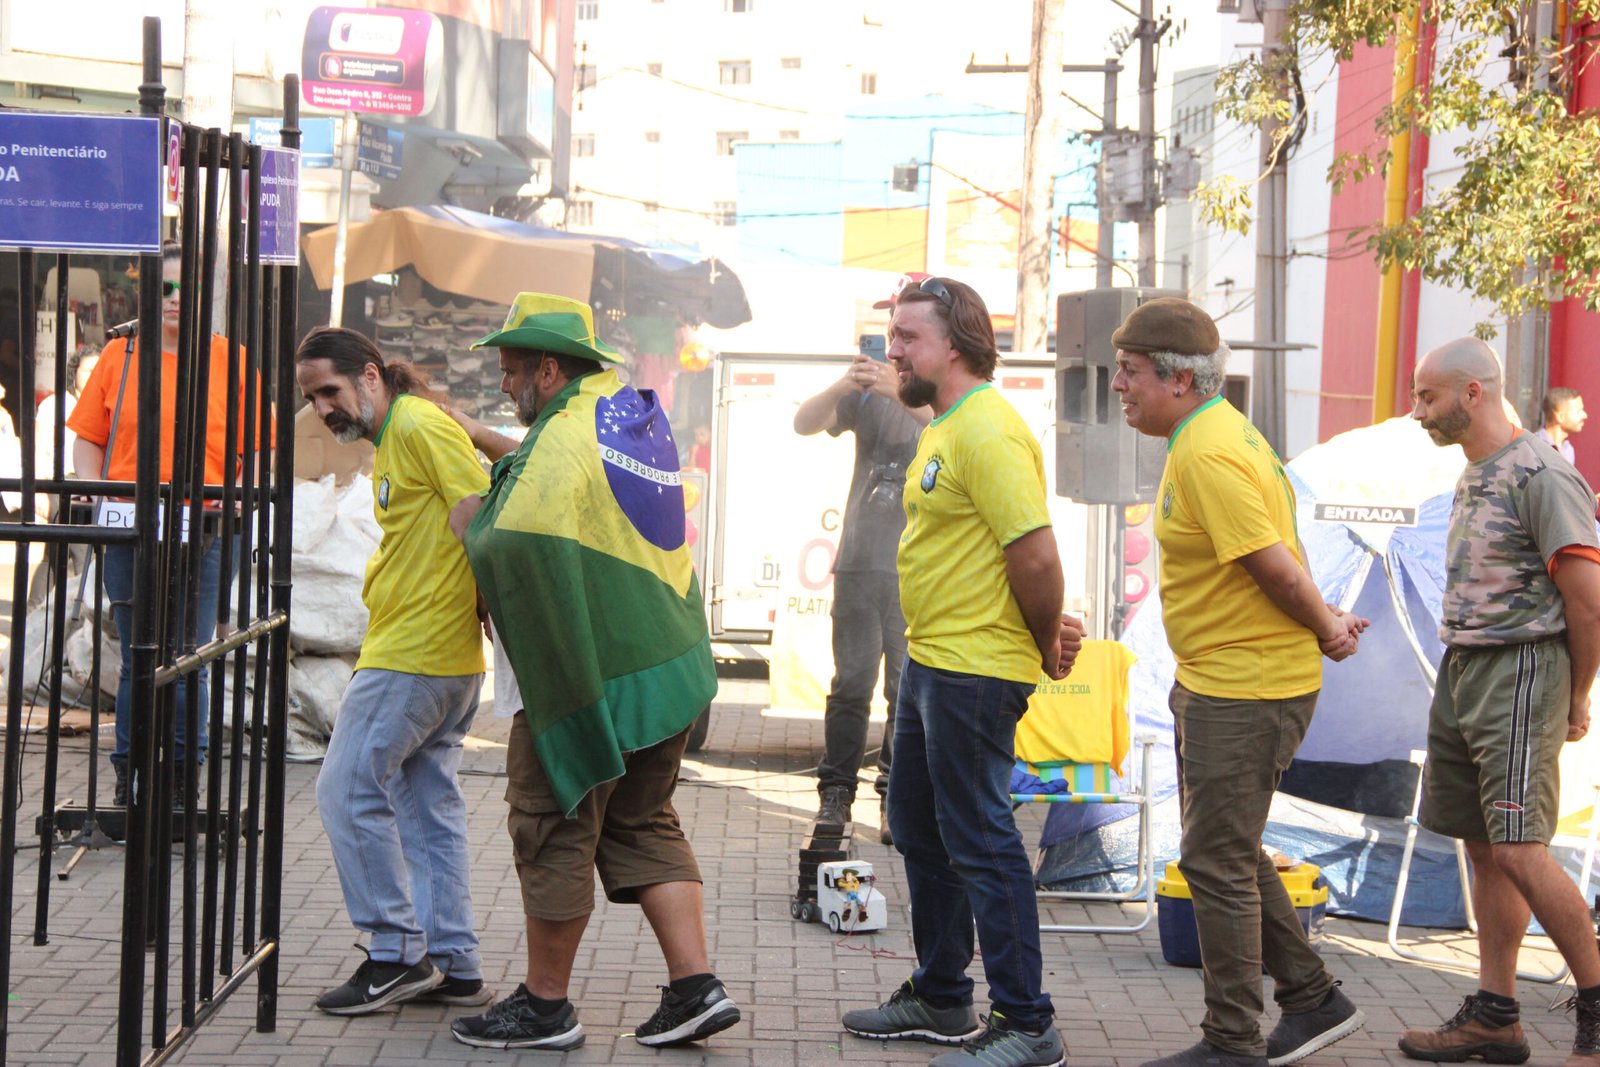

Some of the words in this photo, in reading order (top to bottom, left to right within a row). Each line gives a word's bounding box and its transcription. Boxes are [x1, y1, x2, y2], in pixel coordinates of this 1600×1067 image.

[12, 143, 107, 159] Penitenciário
[17, 198, 28, 207] Se
[30, 199, 49, 208] cair,
[50, 199, 83, 209] levante.
[92, 201, 109, 212] siga
[111, 202, 143, 211] sempre
[605, 448, 670, 484] PROGRESSO
[1323, 506, 1406, 523] ENTRADA
